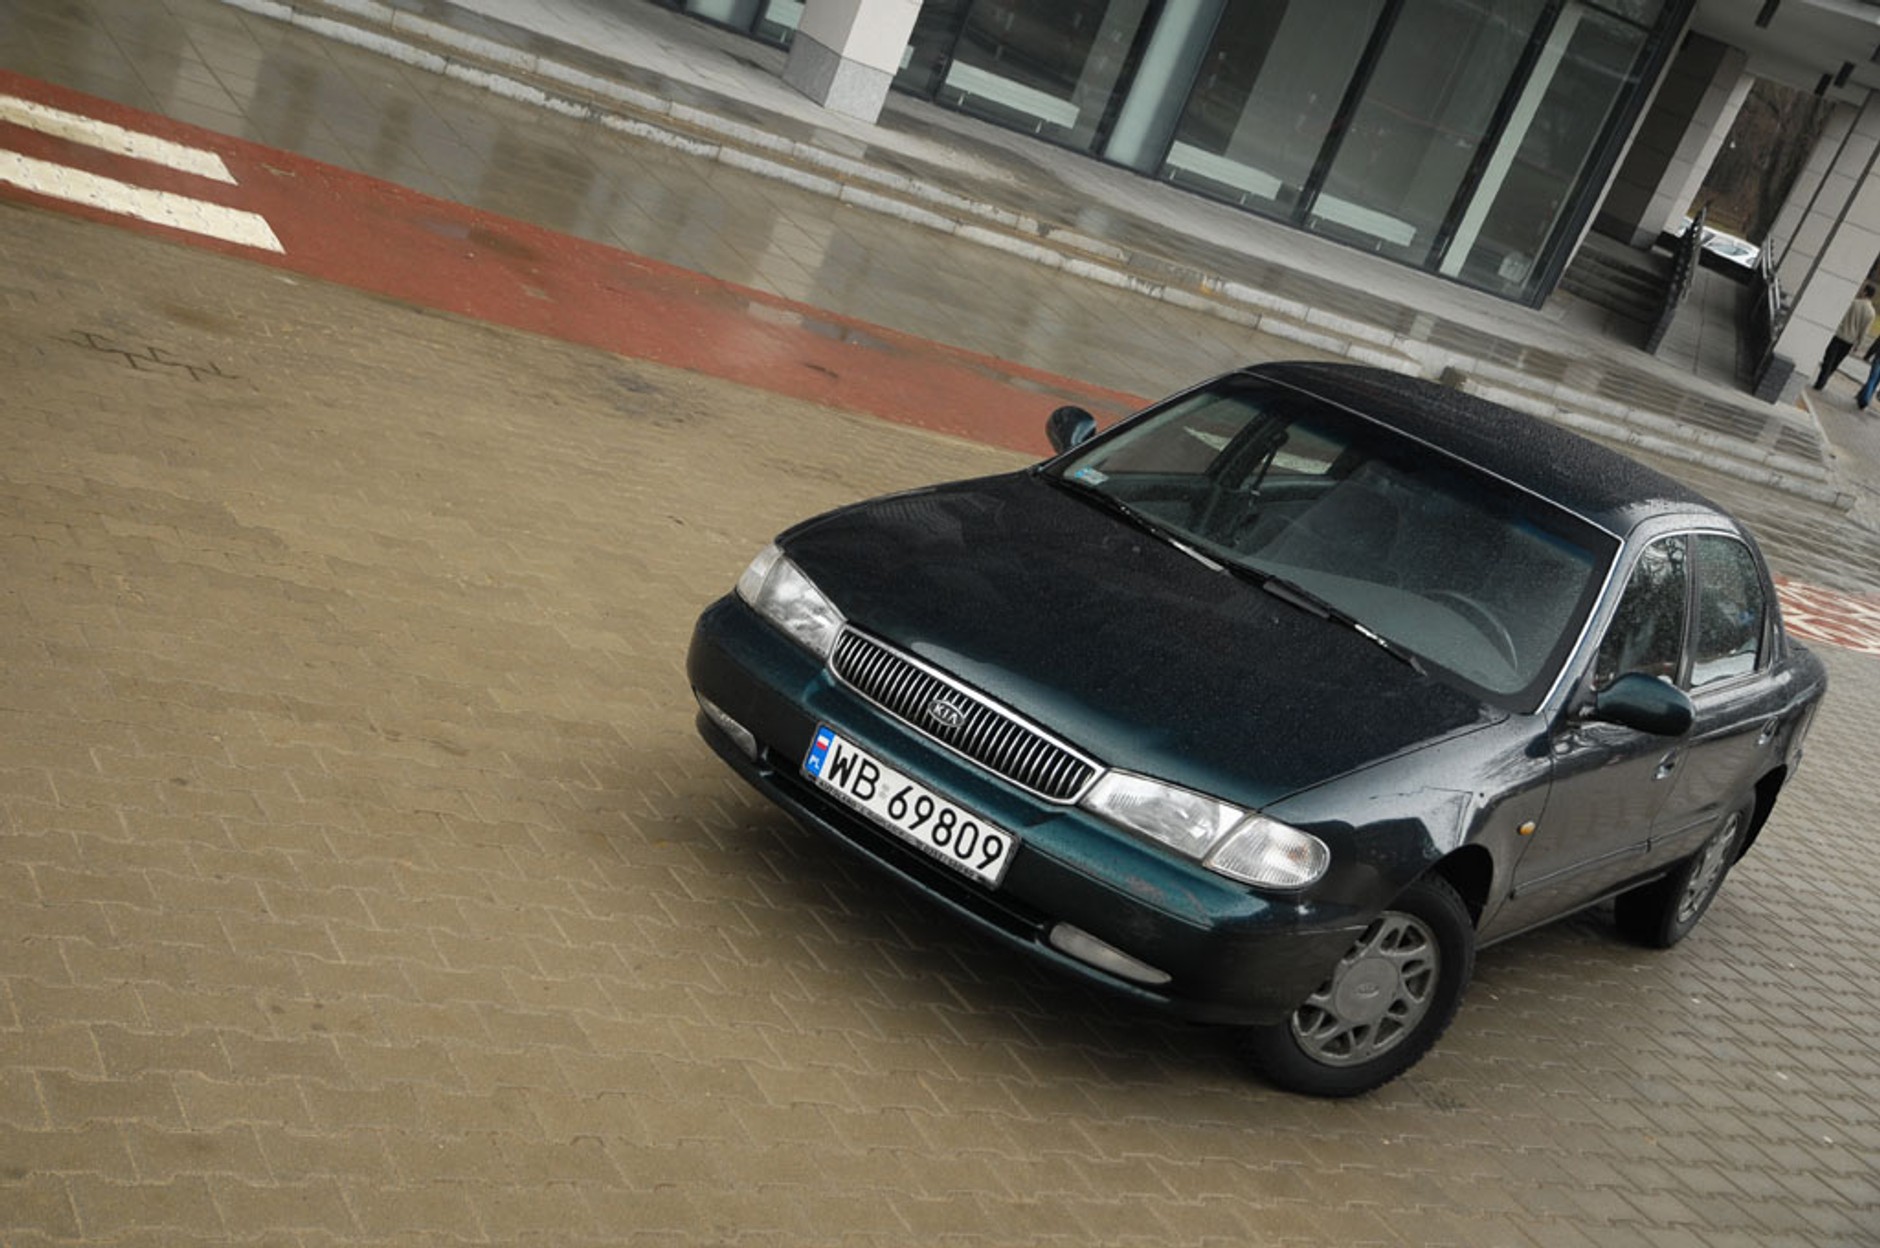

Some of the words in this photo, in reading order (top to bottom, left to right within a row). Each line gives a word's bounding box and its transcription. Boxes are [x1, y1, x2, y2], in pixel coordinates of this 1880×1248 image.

[933, 704, 957, 724] KIA
[808, 755, 820, 769] PL
[828, 743, 881, 801] WB
[887, 785, 1004, 870] 69809
